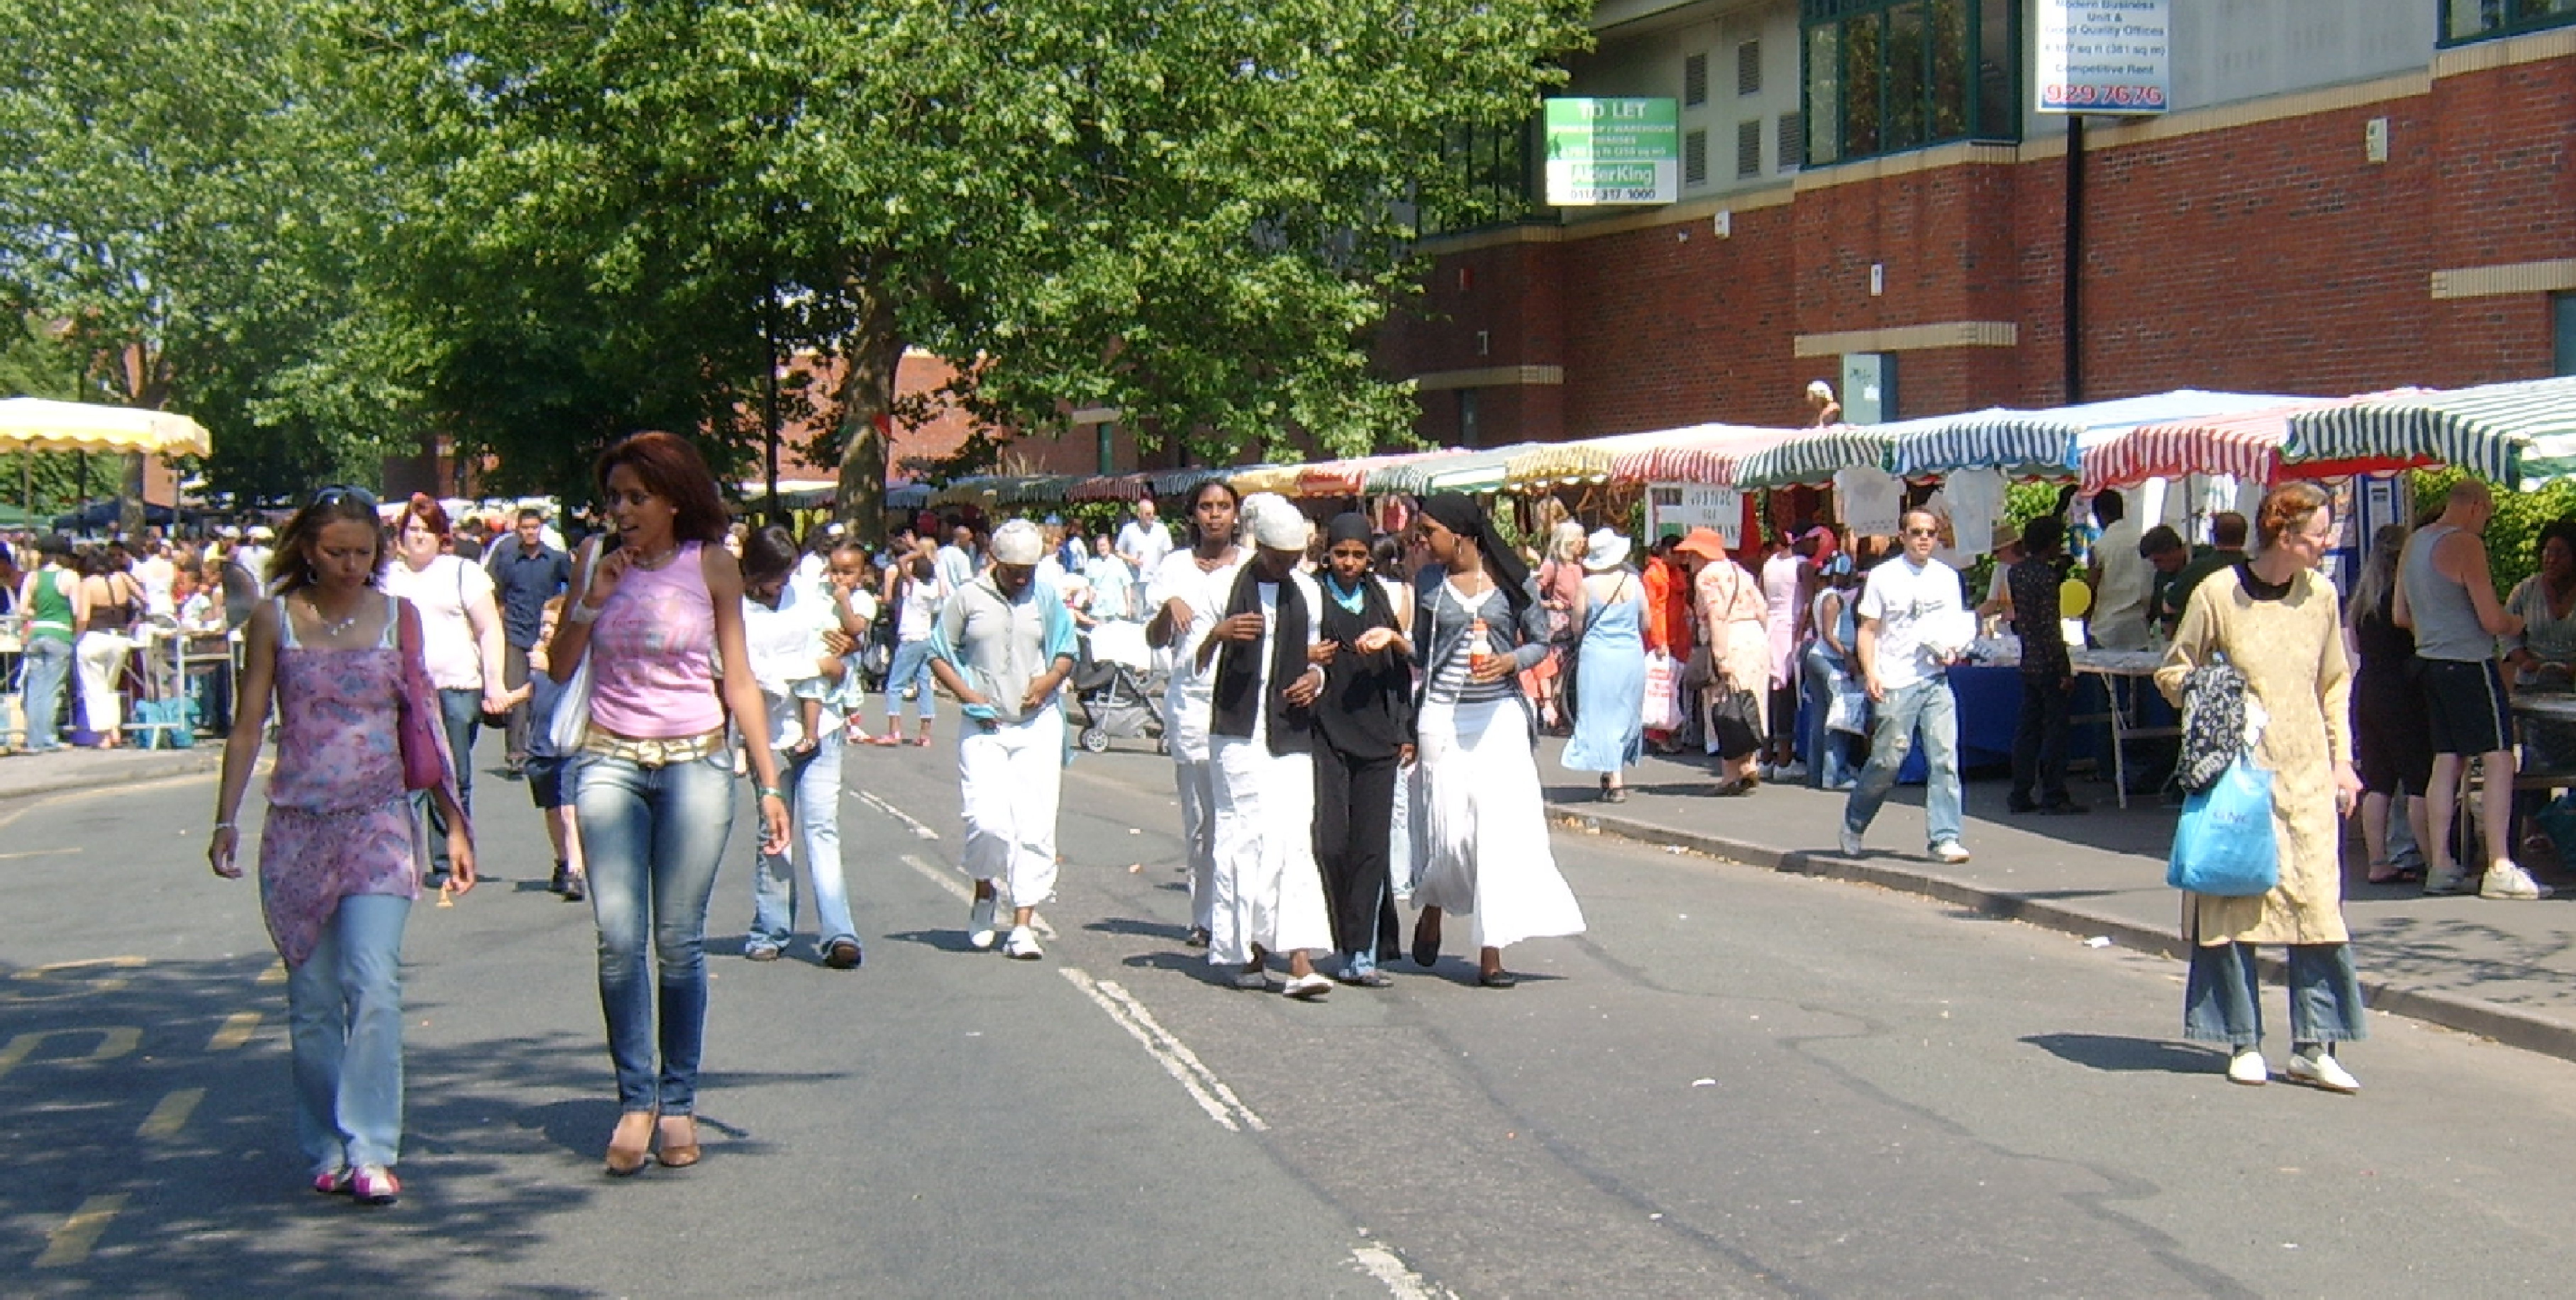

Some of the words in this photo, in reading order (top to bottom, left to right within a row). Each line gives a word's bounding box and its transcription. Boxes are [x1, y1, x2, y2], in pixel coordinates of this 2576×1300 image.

[2087, 12, 2110, 22] Unit
[2114, 11, 2123, 22] &
[2081, 24, 2120, 38] Quality
[2123, 25, 2164, 36] Offices
[2056, 64, 2123, 76] Competitive
[2127, 64, 2154, 74] Rent
[2045, 84, 2096, 103] 929
[2101, 84, 2164, 104] 7676
[1577, 101, 1604, 119] TO
[1612, 101, 1646, 119] LET
[1572, 164, 1653, 185] AlderKing
